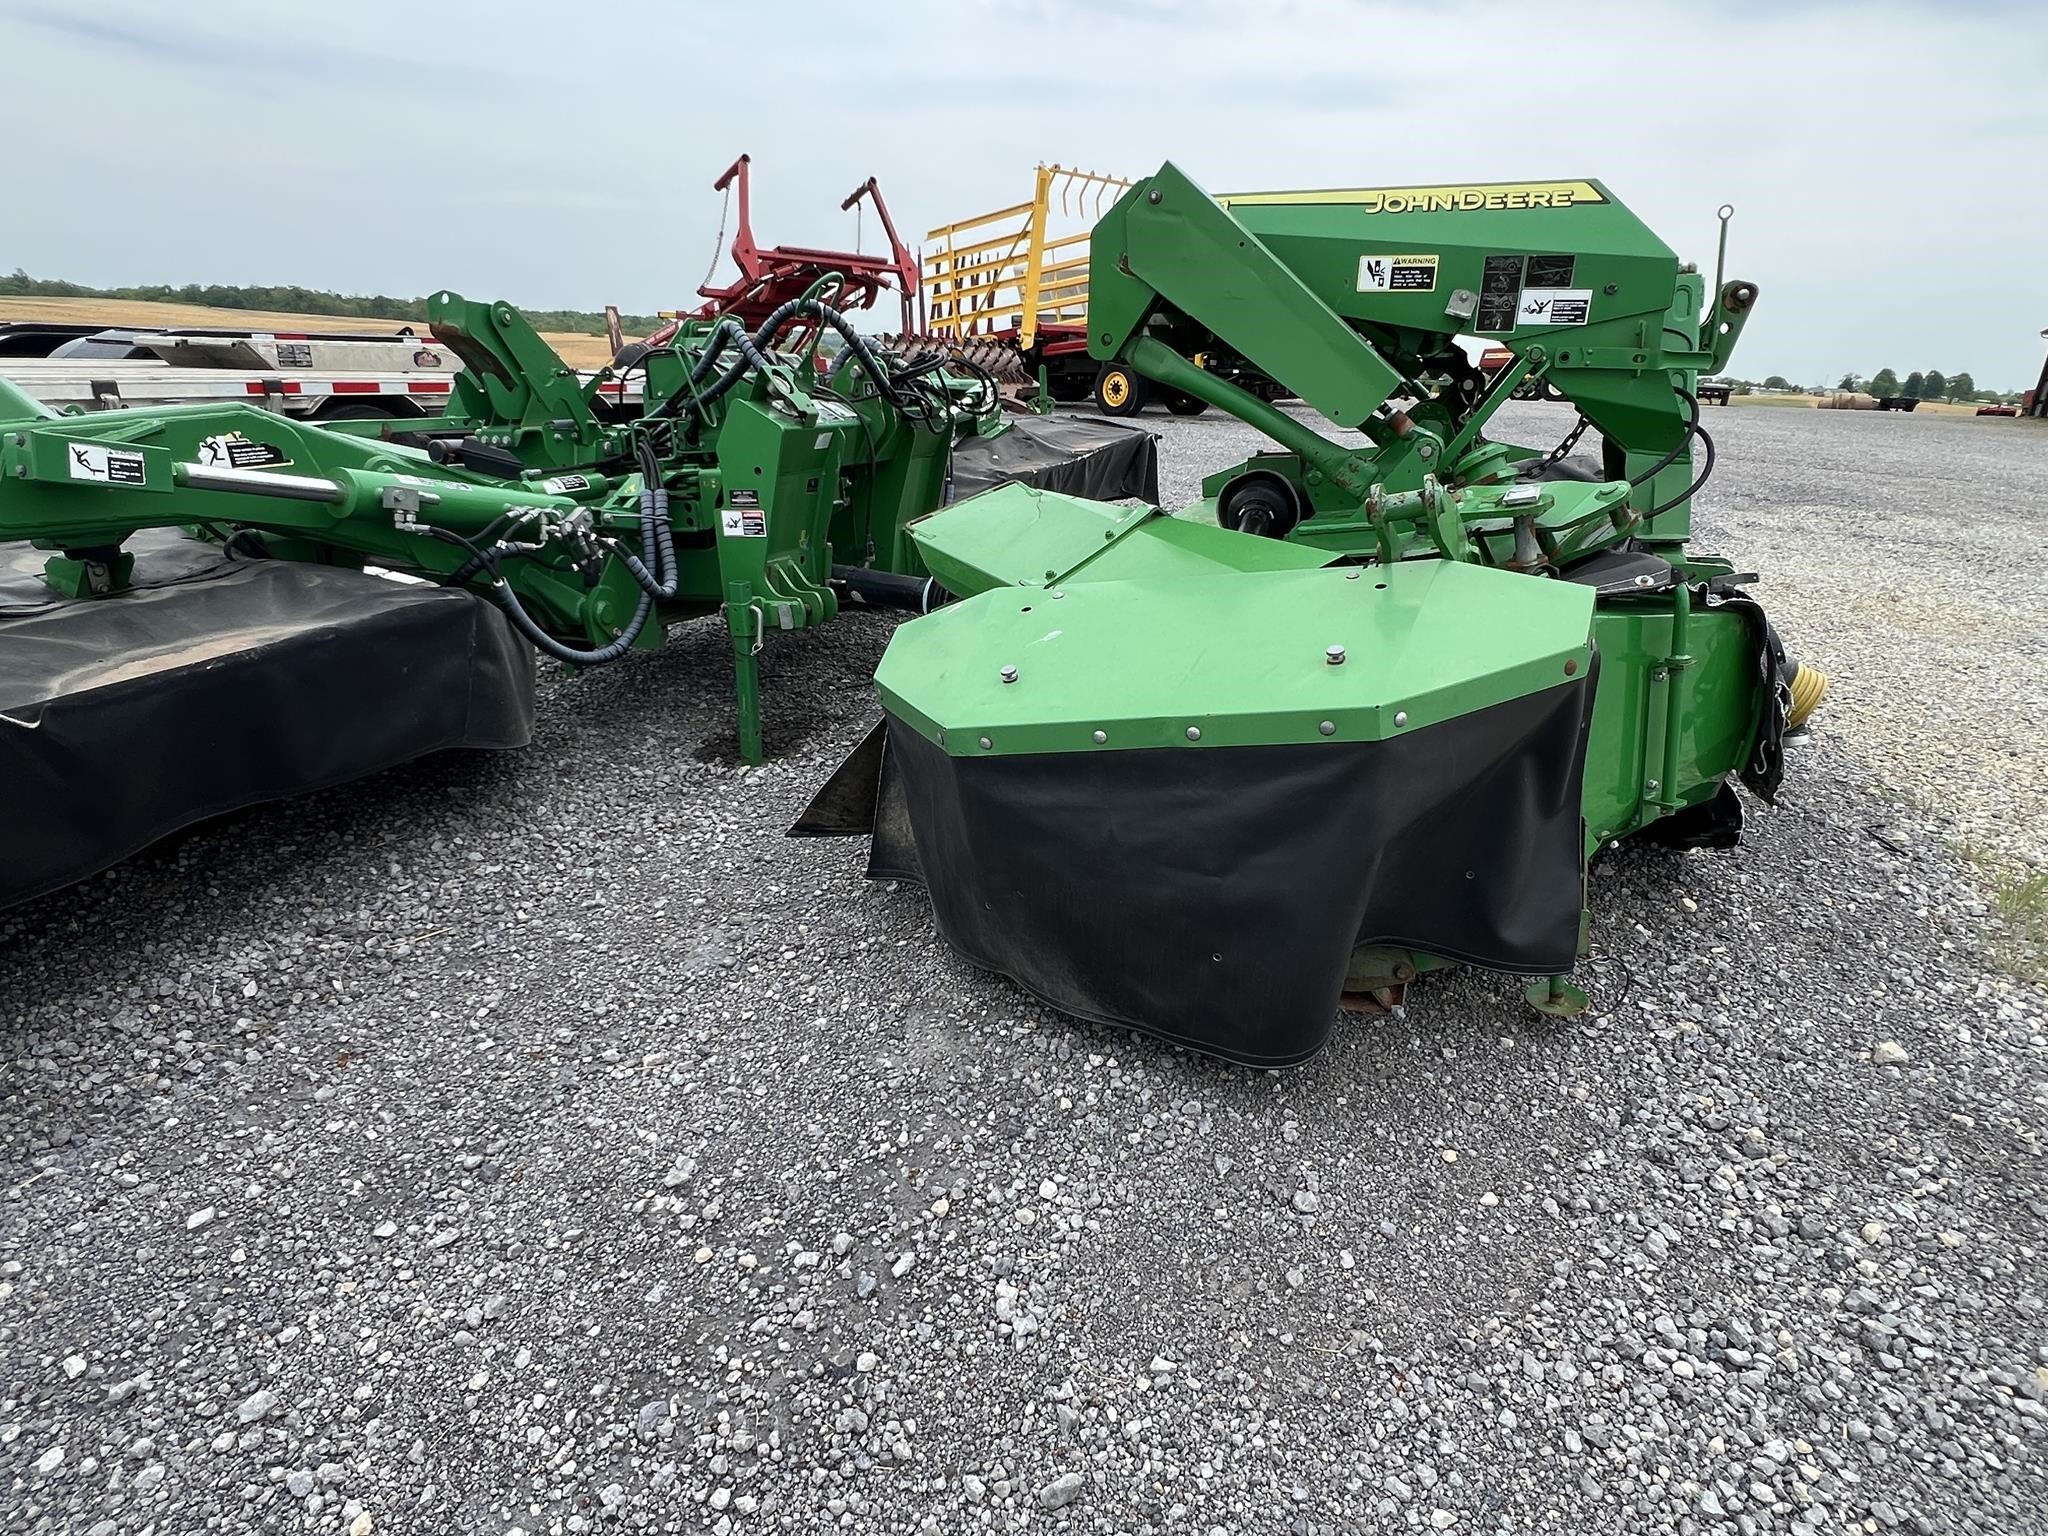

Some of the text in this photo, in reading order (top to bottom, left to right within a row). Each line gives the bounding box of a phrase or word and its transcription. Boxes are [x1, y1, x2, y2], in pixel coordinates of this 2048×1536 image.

[1365, 190, 1574, 214] JOHN DEERE
[1400, 257, 1436, 265] WARNING
